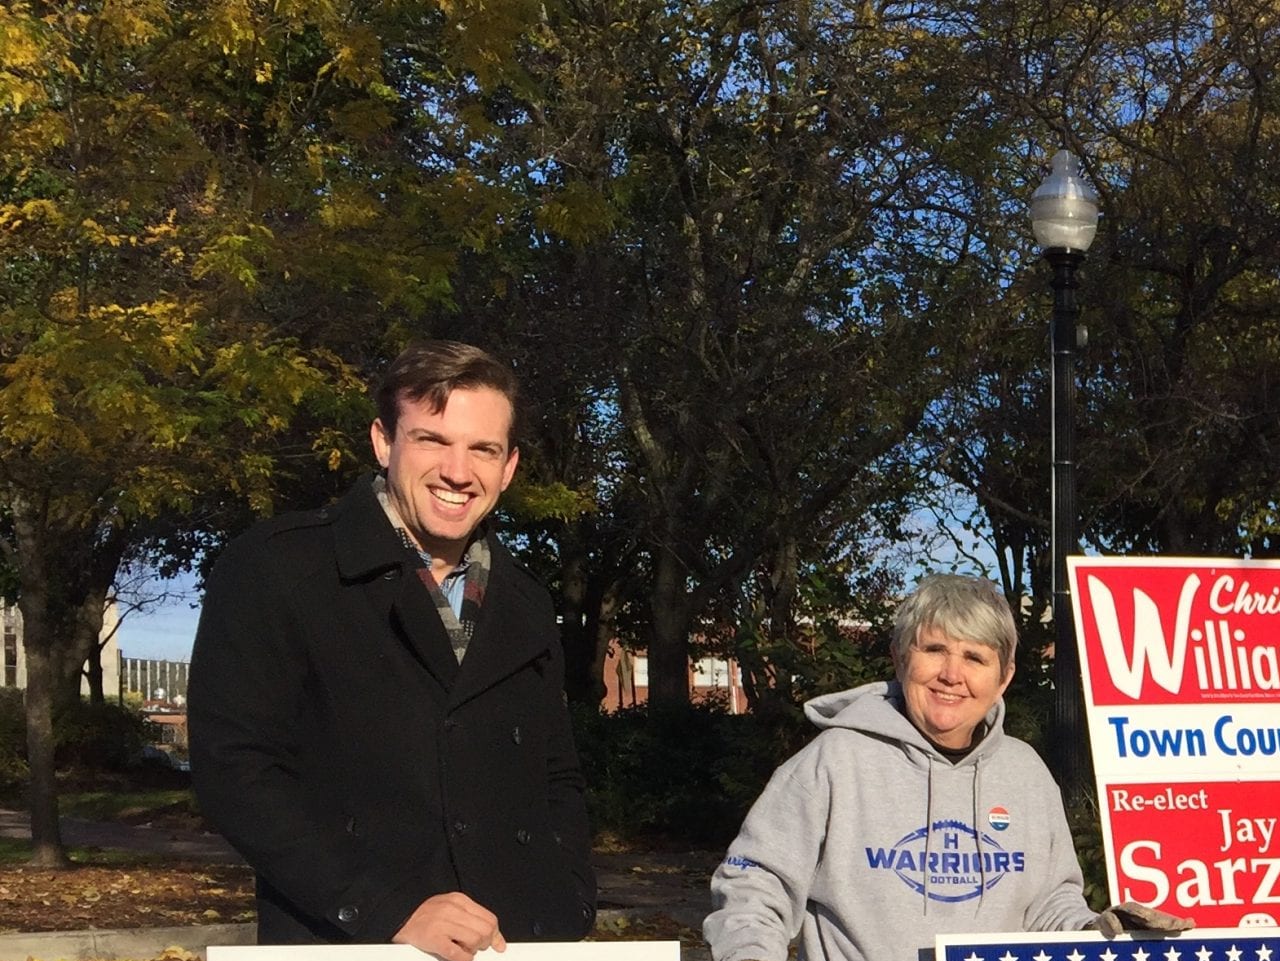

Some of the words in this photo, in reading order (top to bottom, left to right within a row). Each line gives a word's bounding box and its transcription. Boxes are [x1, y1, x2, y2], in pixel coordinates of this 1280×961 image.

[1107, 716, 1207, 759] Town
[1111, 788, 1209, 813] Re-elect
[944, 833, 958, 849] H
[1217, 808, 1277, 853] Jay
[865, 847, 1025, 874] WARRIORS
[929, 876, 979, 884] OOTBALL
